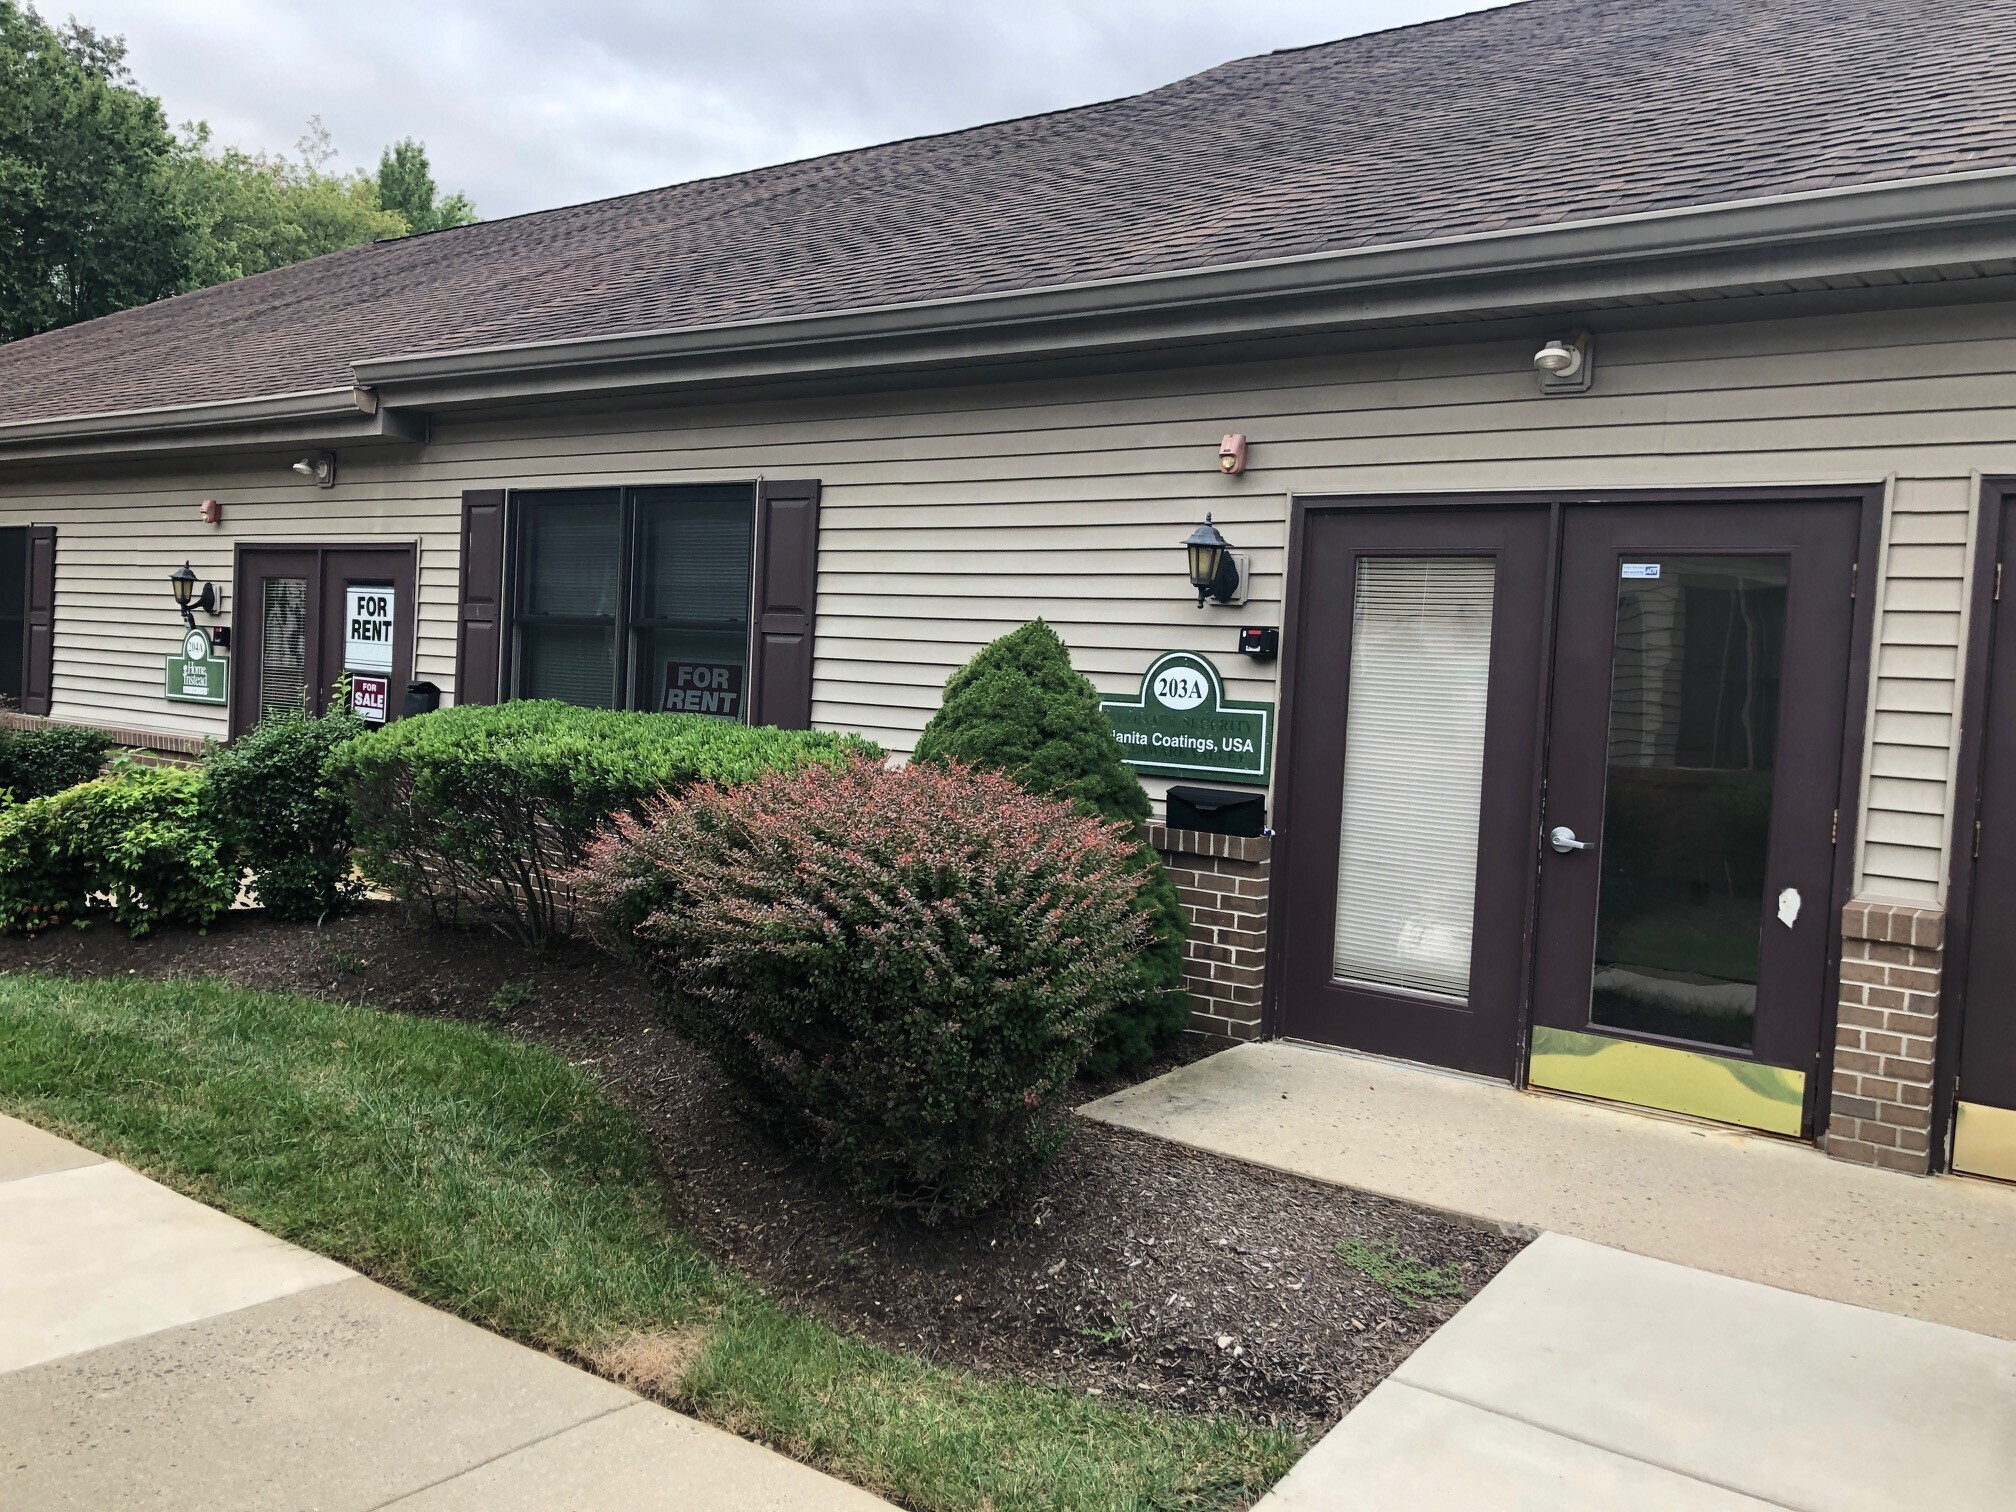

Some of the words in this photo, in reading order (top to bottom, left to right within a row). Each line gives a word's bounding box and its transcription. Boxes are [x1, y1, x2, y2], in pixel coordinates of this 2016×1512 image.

[357, 596, 387, 617] FOR
[351, 619, 392, 642] RENT
[188, 641, 203, 652] 204A
[187, 661, 206, 675] Home
[677, 666, 730, 689] FOR
[183, 673, 208, 686] Instead
[362, 682, 377, 692] FOR
[1158, 677, 1203, 699] 203A
[354, 692, 384, 707] SALE
[666, 688, 737, 713] RENT
[1152, 732, 1218, 753] Coatings,
[1222, 737, 1254, 752] USA
